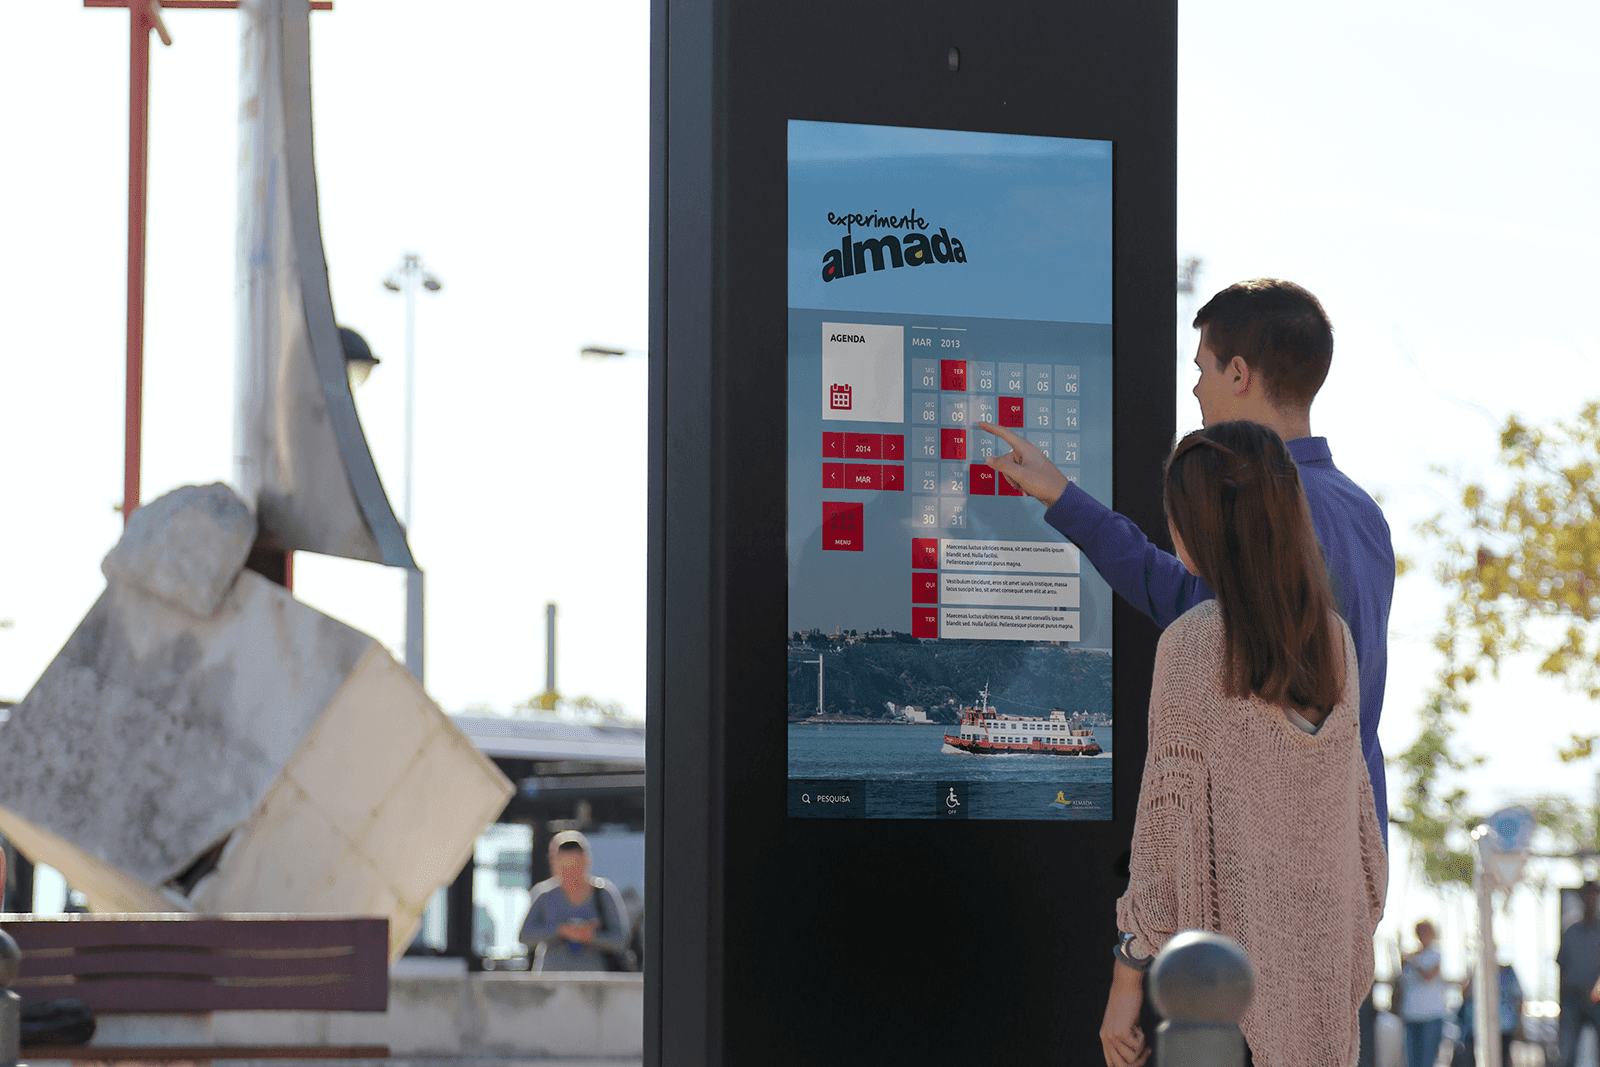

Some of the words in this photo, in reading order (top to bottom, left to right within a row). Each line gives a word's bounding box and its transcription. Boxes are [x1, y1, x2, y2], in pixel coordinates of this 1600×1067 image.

[828, 208, 930, 234] experimente
[822, 227, 968, 282] almada
[830, 334, 866, 343] AGENDA
[912, 338, 932, 347] MAR
[941, 339, 960, 348] 2013
[923, 376, 934, 386] 01
[952, 378, 963, 387] 02
[980, 378, 992, 388] 03
[1009, 380, 1020, 390] 04
[1037, 381, 1049, 391] 05
[1065, 382, 1077, 392] 06
[923, 411, 935, 421] 08
[952, 412, 964, 422] 09
[981, 413, 992, 423] 10
[1010, 415, 1020, 424] 12
[1038, 416, 1048, 426] 13
[1066, 417, 1077, 427] 14
[924, 445, 935, 455] 16
[981, 448, 992, 457] 18
[1066, 451, 1076, 461] 21
[923, 480, 935, 490] 23
[952, 481, 963, 491] 24
[923, 514, 935, 524] 30
[952, 515, 962, 525] 31
[923, 556, 934, 565] 02
[817, 795, 851, 803] PESQUISA
